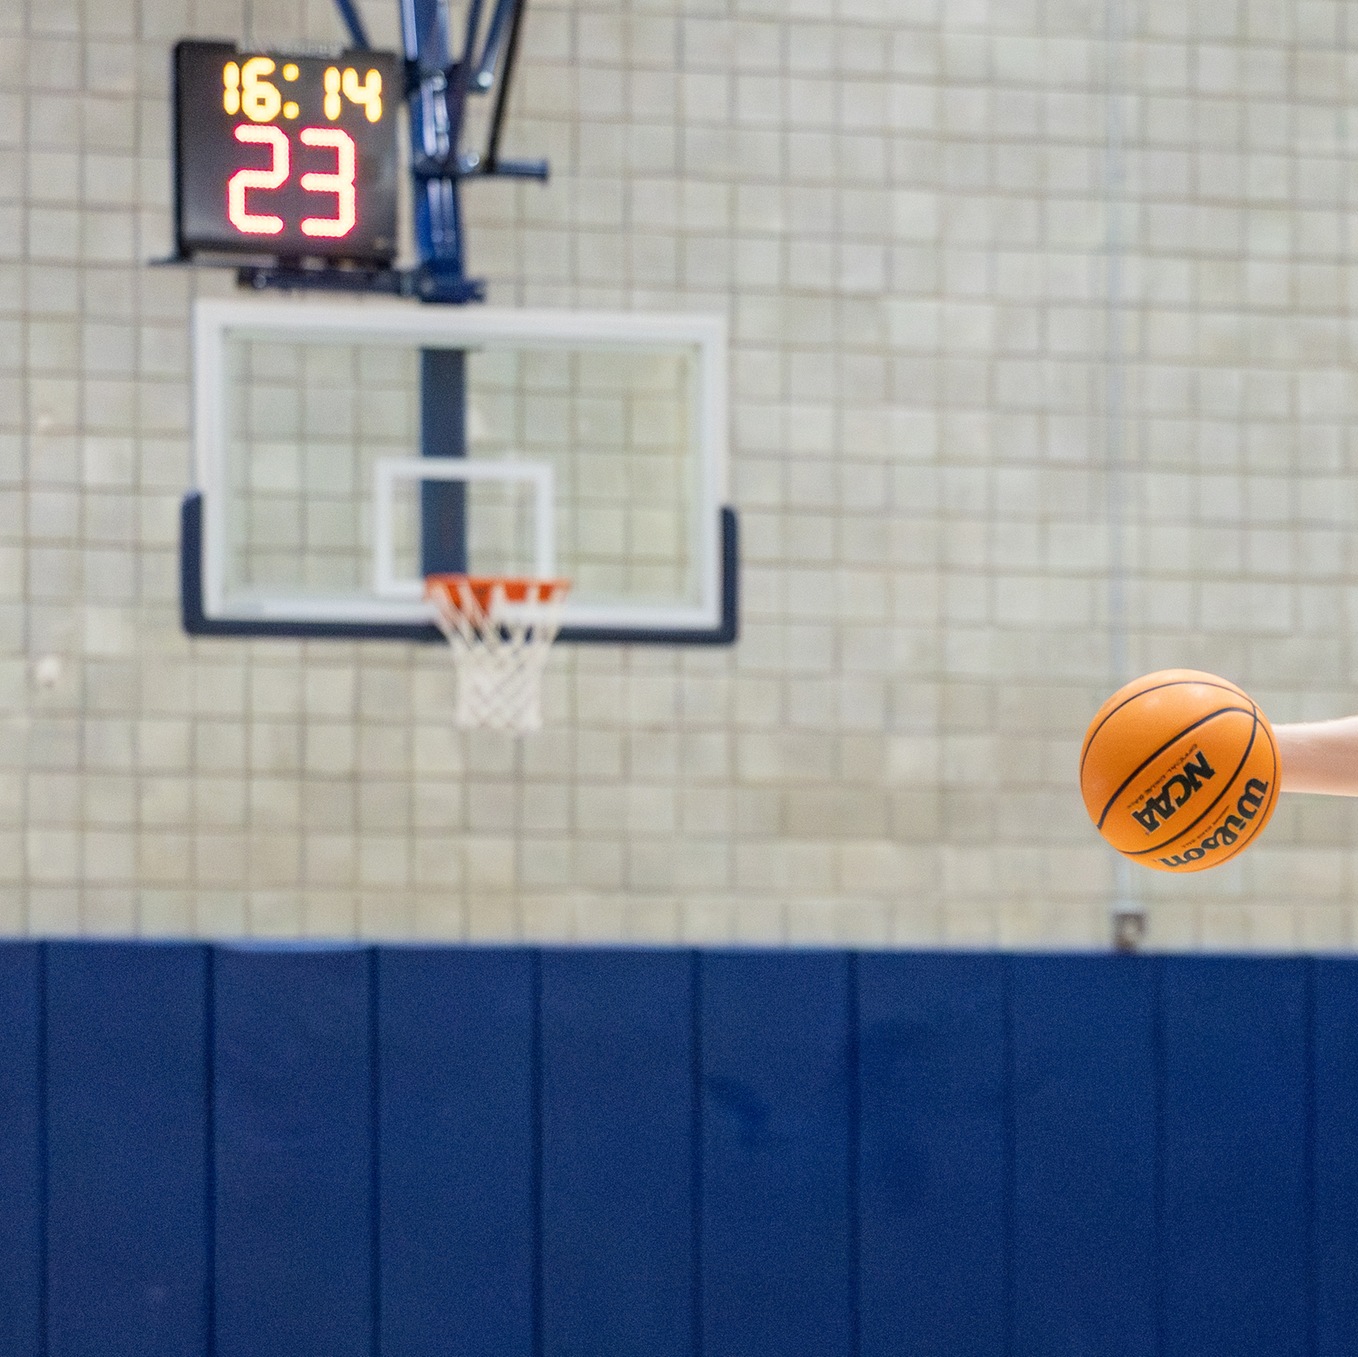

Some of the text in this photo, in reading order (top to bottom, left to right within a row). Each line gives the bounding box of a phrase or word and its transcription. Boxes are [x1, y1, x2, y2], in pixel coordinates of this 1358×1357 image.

[222, 56, 384, 123] 16:14
[228, 124, 357, 238] 23
[1131, 750, 1216, 833] NCAA
[1160, 778, 1269, 867] Wilson
